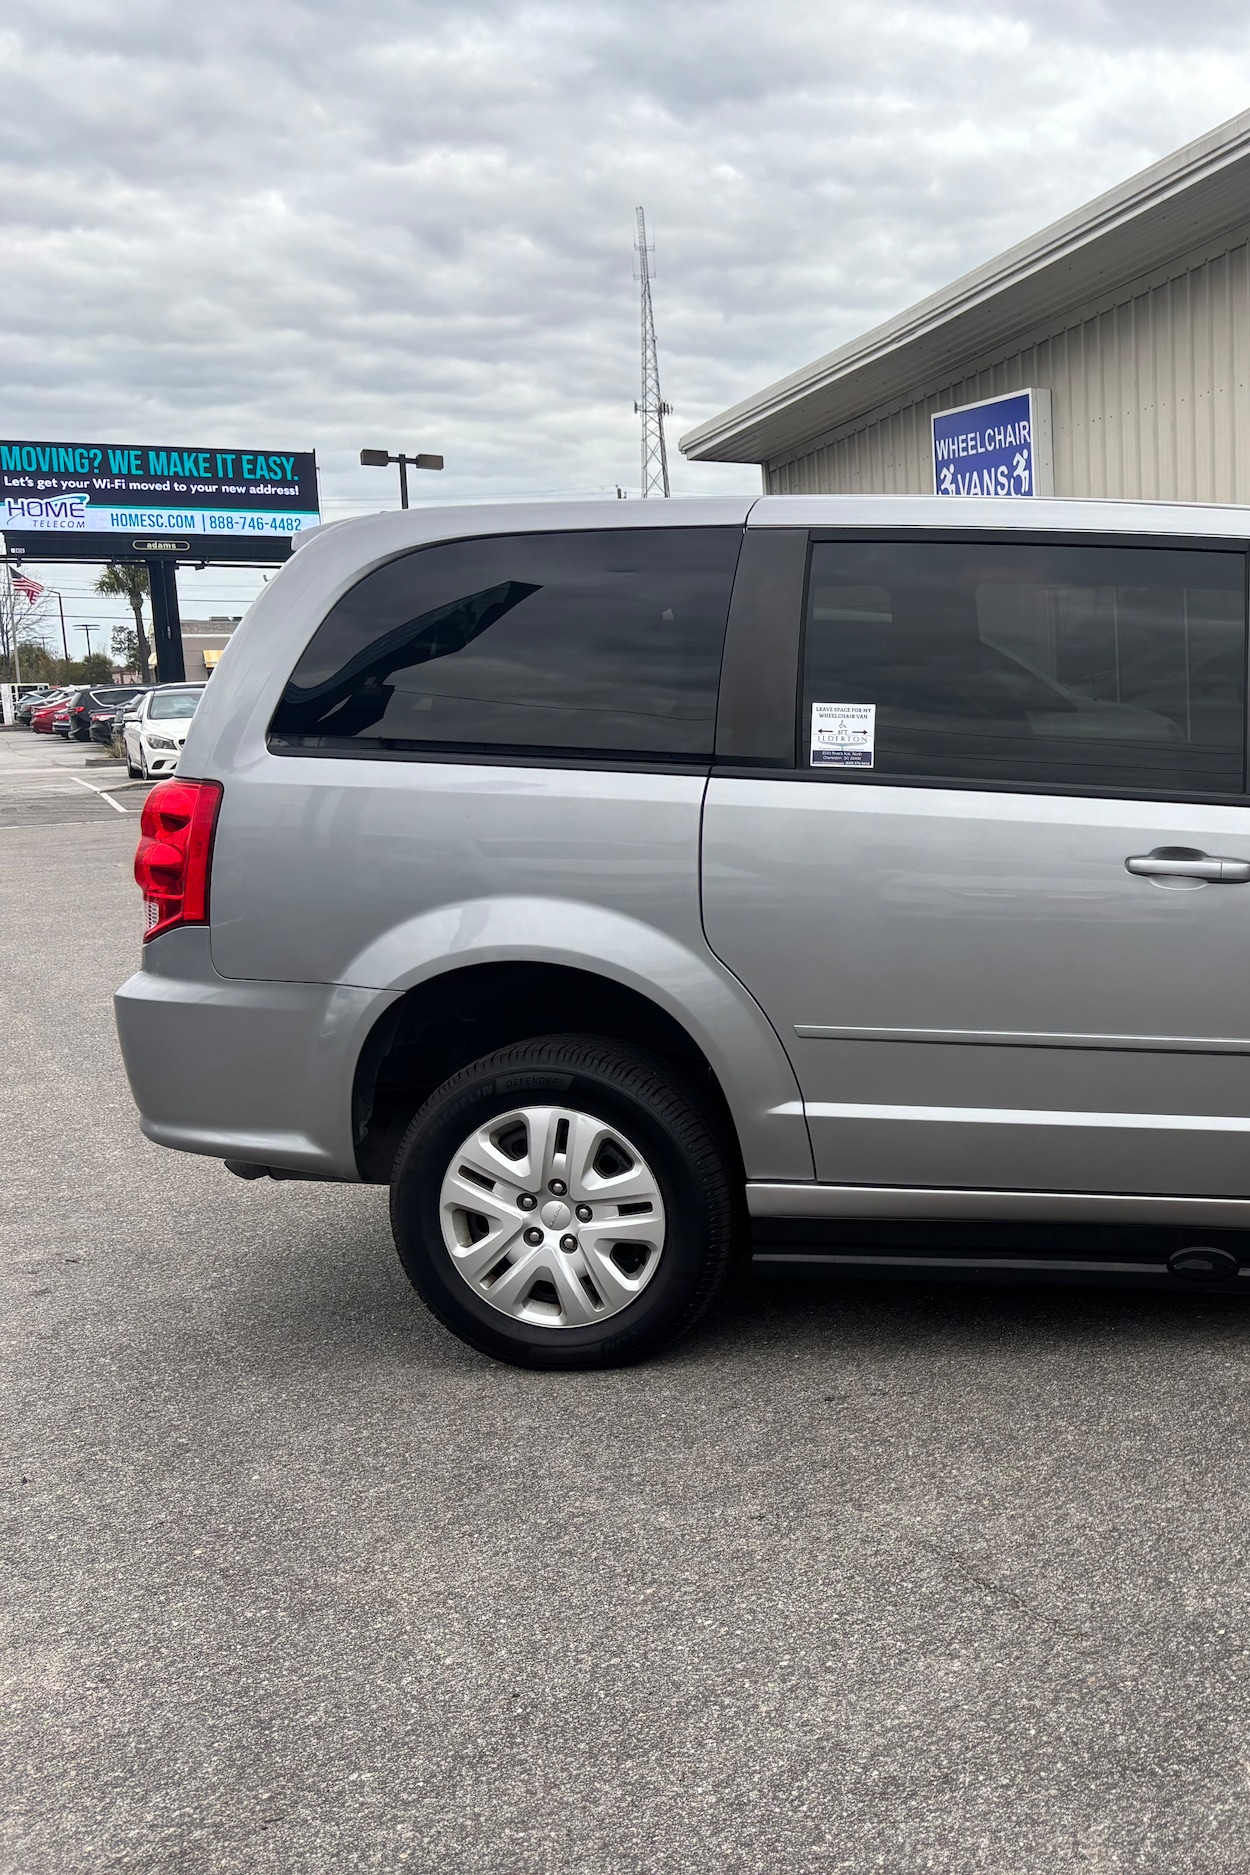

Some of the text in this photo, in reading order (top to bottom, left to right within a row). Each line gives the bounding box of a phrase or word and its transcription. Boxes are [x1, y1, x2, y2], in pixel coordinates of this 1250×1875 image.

[936, 420, 1031, 461] WHEELCHAIR
[0, 445, 299, 481] MOVING? WE MAKE IT EASY.
[37, 477, 58, 490] get
[60, 479, 91, 491] your
[92, 478, 126, 491] Wi-Fi
[128, 480, 171, 493] moved
[173, 481, 188, 493] to
[190, 484, 219, 495] your
[221, 484, 247, 495] new
[249, 483, 300, 496] address!
[957, 465, 1009, 496] VANS
[7, 499, 86, 519] HOME
[32, 518, 86, 529] TELECOM
[110, 512, 302, 532] HOMESC.COM 888-746-4482
[145, 540, 178, 550] adams
